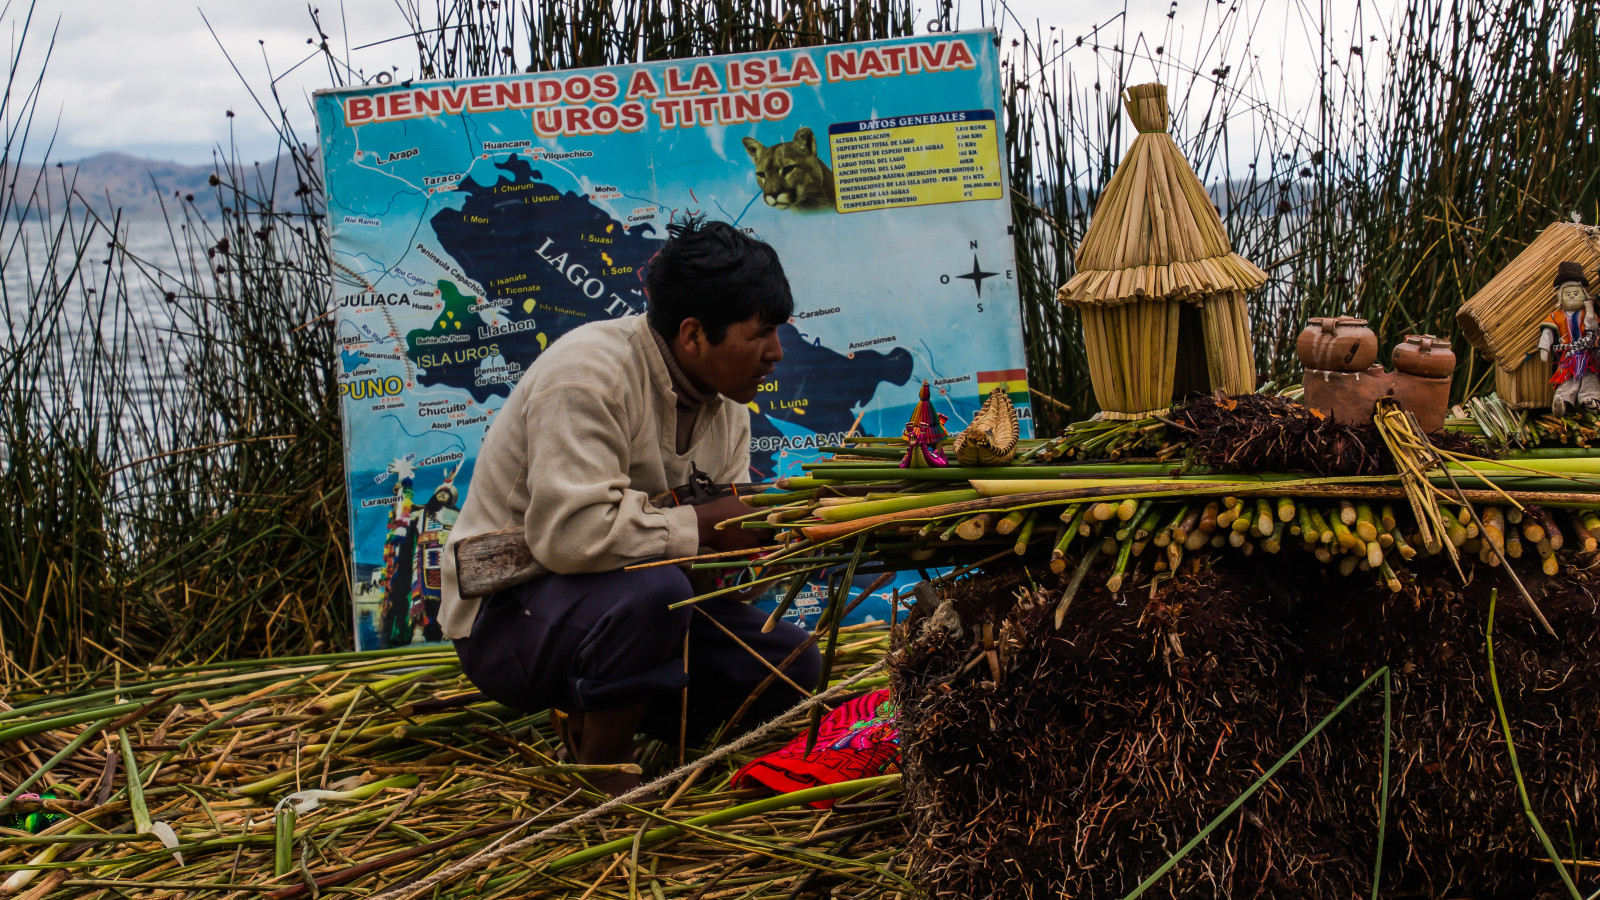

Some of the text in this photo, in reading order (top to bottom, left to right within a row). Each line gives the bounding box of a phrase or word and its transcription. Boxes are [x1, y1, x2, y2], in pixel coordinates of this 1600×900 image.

[346, 43, 974, 123] BIENVENIDOS A LA ISLA NATIVA
[535, 91, 790, 135] UROS TITINO
[859, 112, 966, 131] DATOS GENERALES
[835, 132, 890, 144] ALTURA UBICACIÓN
[483, 139, 531, 151] Huancane
[836, 143, 870, 152] SUPERFICIE
[389, 147, 419, 163] Arapa
[542, 150, 593, 160] Vilquechico
[837, 152, 871, 160] SUPERFICIE
[881, 147, 902, 155] ESPEJO
[924, 143, 944, 151] AGUAS
[837, 160, 857, 168] LARGO
[889, 155, 905, 163] LAGO
[838, 168, 858, 176] ANCHO
[890, 163, 906, 171] LAGO
[423, 173, 461, 186] Taraco
[839, 175, 881, 185] PROFUNDIDAD
[882, 171, 905, 180] MÁXIMA
[501, 182, 534, 193] Churuni
[594, 185, 617, 193] Moho
[840, 182, 885, 193] INMEDIACIONES
[532, 194, 559, 203] Ustuto
[841, 193, 868, 201] VOLUMEN
[843, 196, 917, 209] TEMPERATURA PROMEDIO
[358, 217, 380, 226] Ramis
[471, 215, 489, 224] Mori
[627, 213, 655, 222] Conima
[588, 235, 613, 244] Suasi
[969, 240, 978, 249] N
[415, 243, 487, 299] Peninsula Capachica
[534, 237, 605, 299] LAGO
[611, 266, 633, 275] Soto
[393, 266, 427, 286] Rio Coata
[496, 273, 527, 285] Isanata
[940, 274, 950, 284] O
[1006, 270, 1013, 279] E
[413, 289, 434, 298] Coata
[505, 284, 541, 295] Ticonata
[340, 293, 410, 307] JULIACA
[467, 297, 513, 313] Capachica
[411, 302, 433, 311] Huata
[798, 305, 841, 320] Carabuco
[977, 303, 984, 313] S
[361, 323, 372, 335] Rio
[478, 319, 536, 339] Llachon
[439, 334, 448, 342] de
[448, 333, 470, 343] Puno
[848, 334, 897, 350] Ancoraimes
[359, 350, 401, 361] Paucarcolla
[416, 343, 500, 369] ISLA UROS
[352, 367, 378, 378] Umayo
[475, 362, 520, 378] Peninsula
[475, 377, 487, 386] de
[933, 374, 971, 386] Achacachi
[338, 375, 404, 401] PUNO
[780, 397, 809, 409] Luna
[418, 402, 467, 417] Chucuito
[431, 414, 487, 430] Atoja Plateria
[424, 451, 463, 466] Cutimbo
[374, 472, 388, 485] Rio
[362, 493, 404, 508] Laraqueri
[798, 606, 821, 615] Tanka
